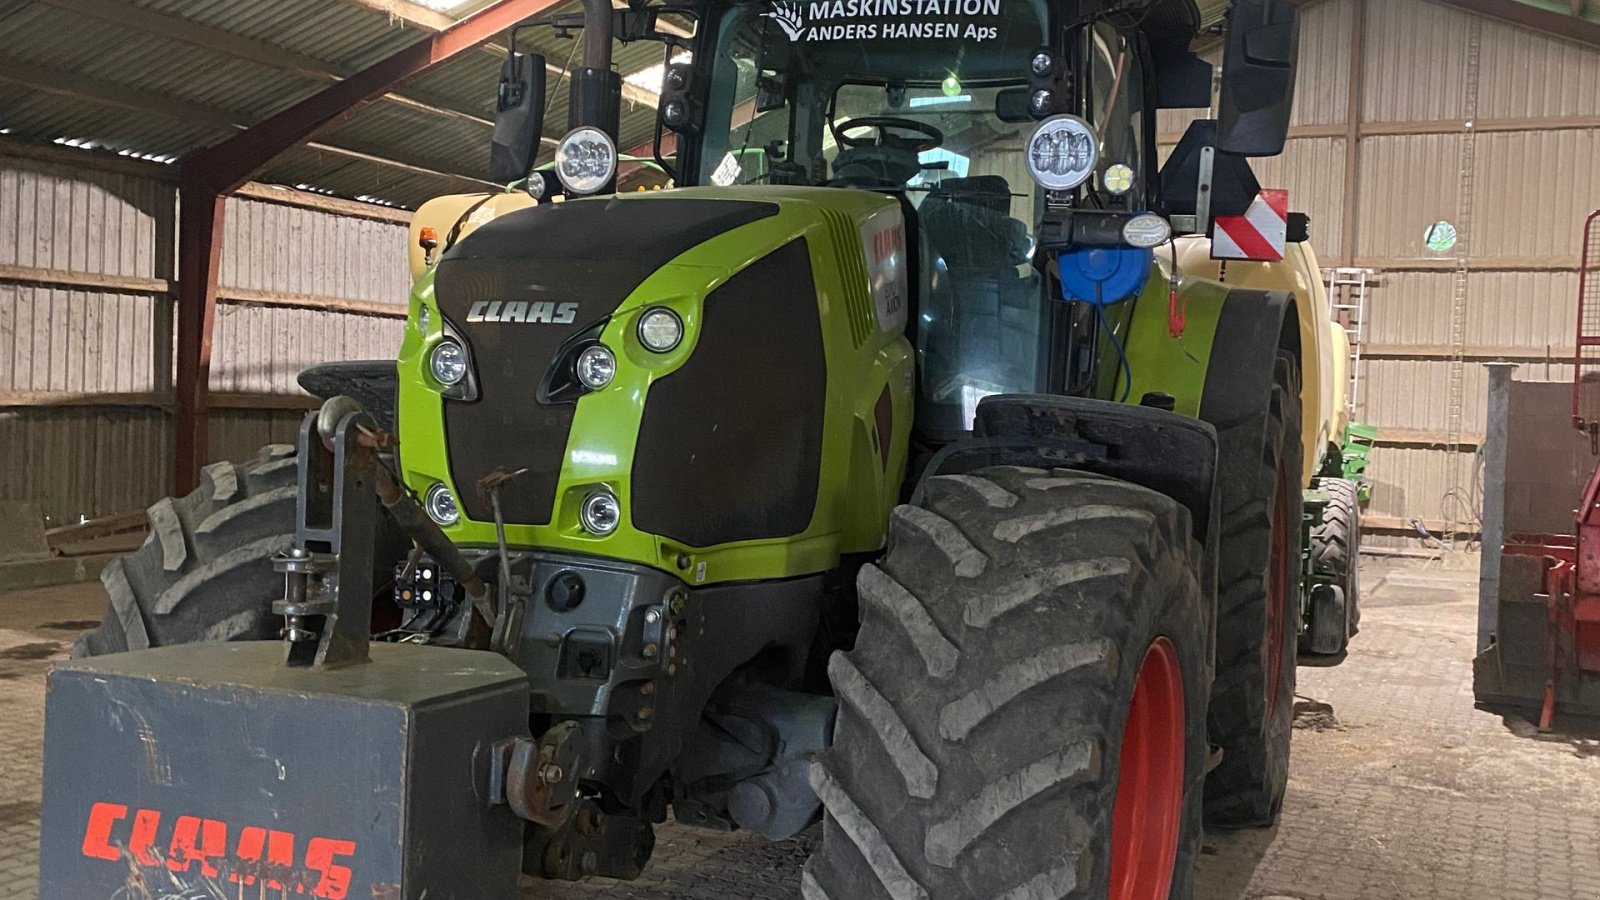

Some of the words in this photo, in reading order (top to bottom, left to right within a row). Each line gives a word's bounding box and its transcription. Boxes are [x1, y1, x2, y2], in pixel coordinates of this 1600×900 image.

[809, 0, 999, 20] MASKINSTATION
[806, 24, 877, 41] ANDERS
[882, 23, 959, 39] HANSEN
[963, 23, 998, 42] Aps
[466, 301, 579, 323] CLAAS
[82, 802, 356, 900] CLAAS
